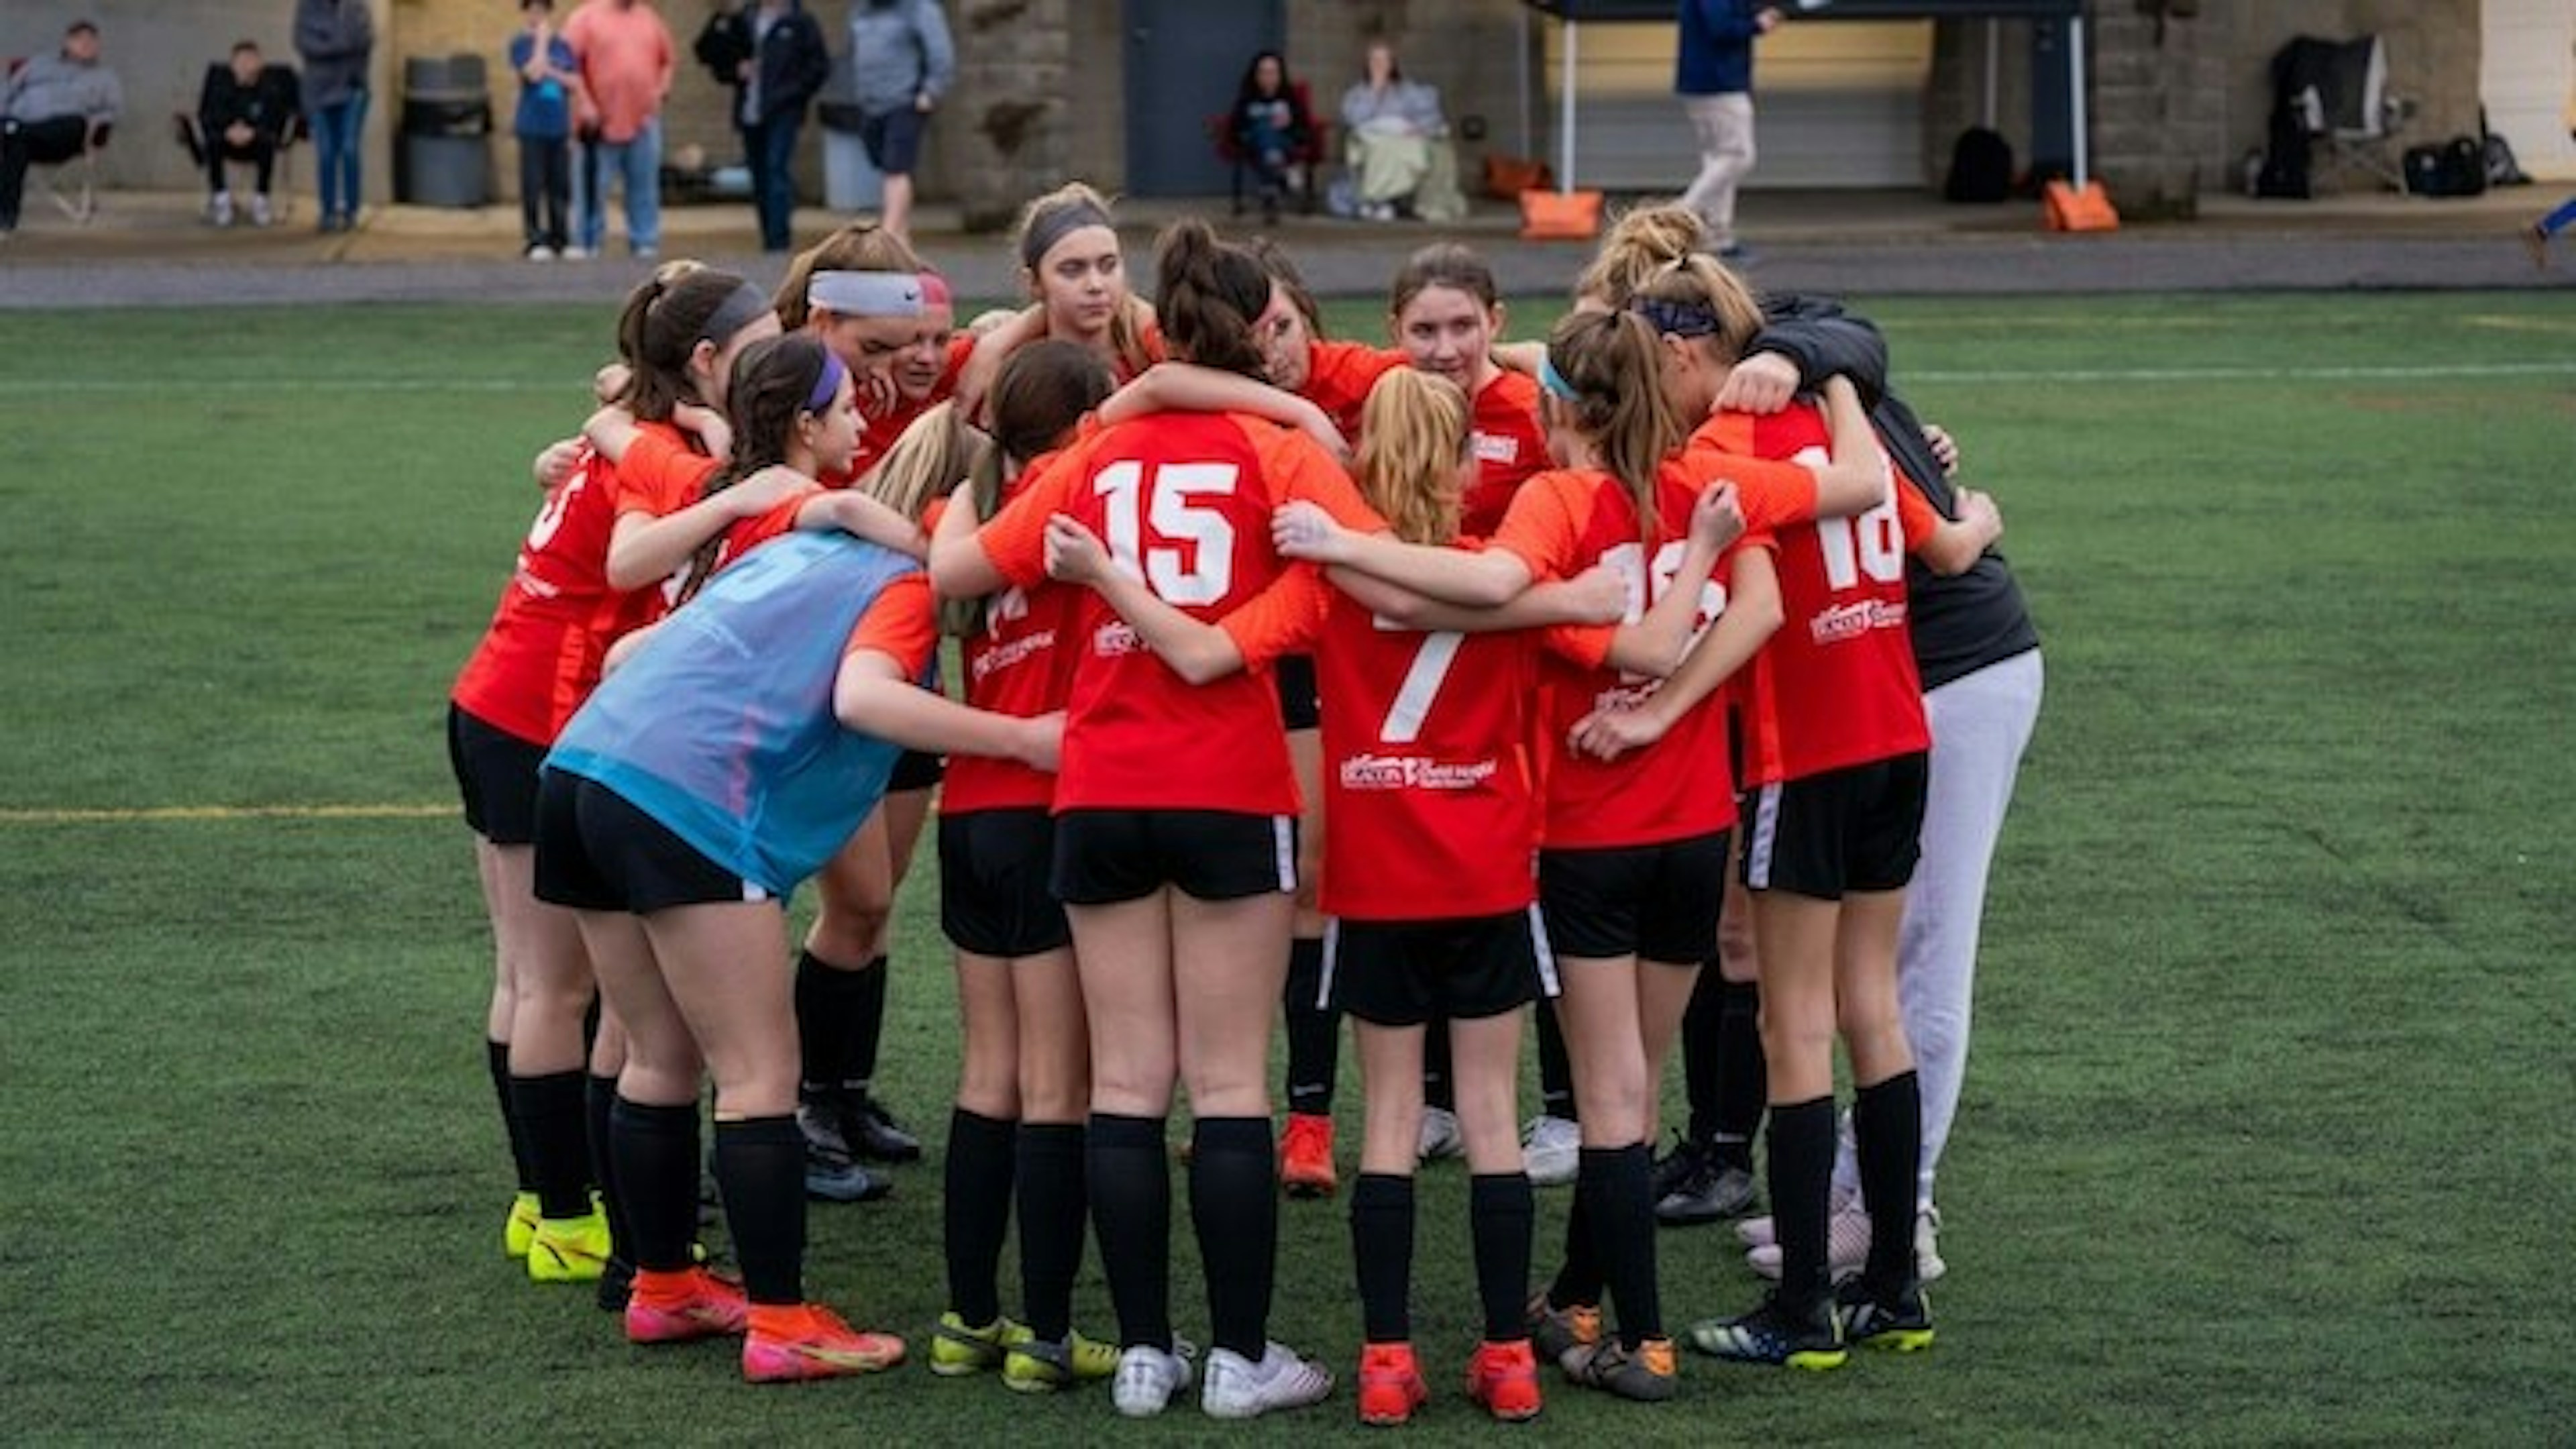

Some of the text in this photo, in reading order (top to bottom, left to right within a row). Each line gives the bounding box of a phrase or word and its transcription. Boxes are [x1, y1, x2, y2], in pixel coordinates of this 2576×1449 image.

[1093, 460, 1240, 605] 15
[1788, 445, 1906, 590] 18
[1372, 612, 1466, 743] 7
